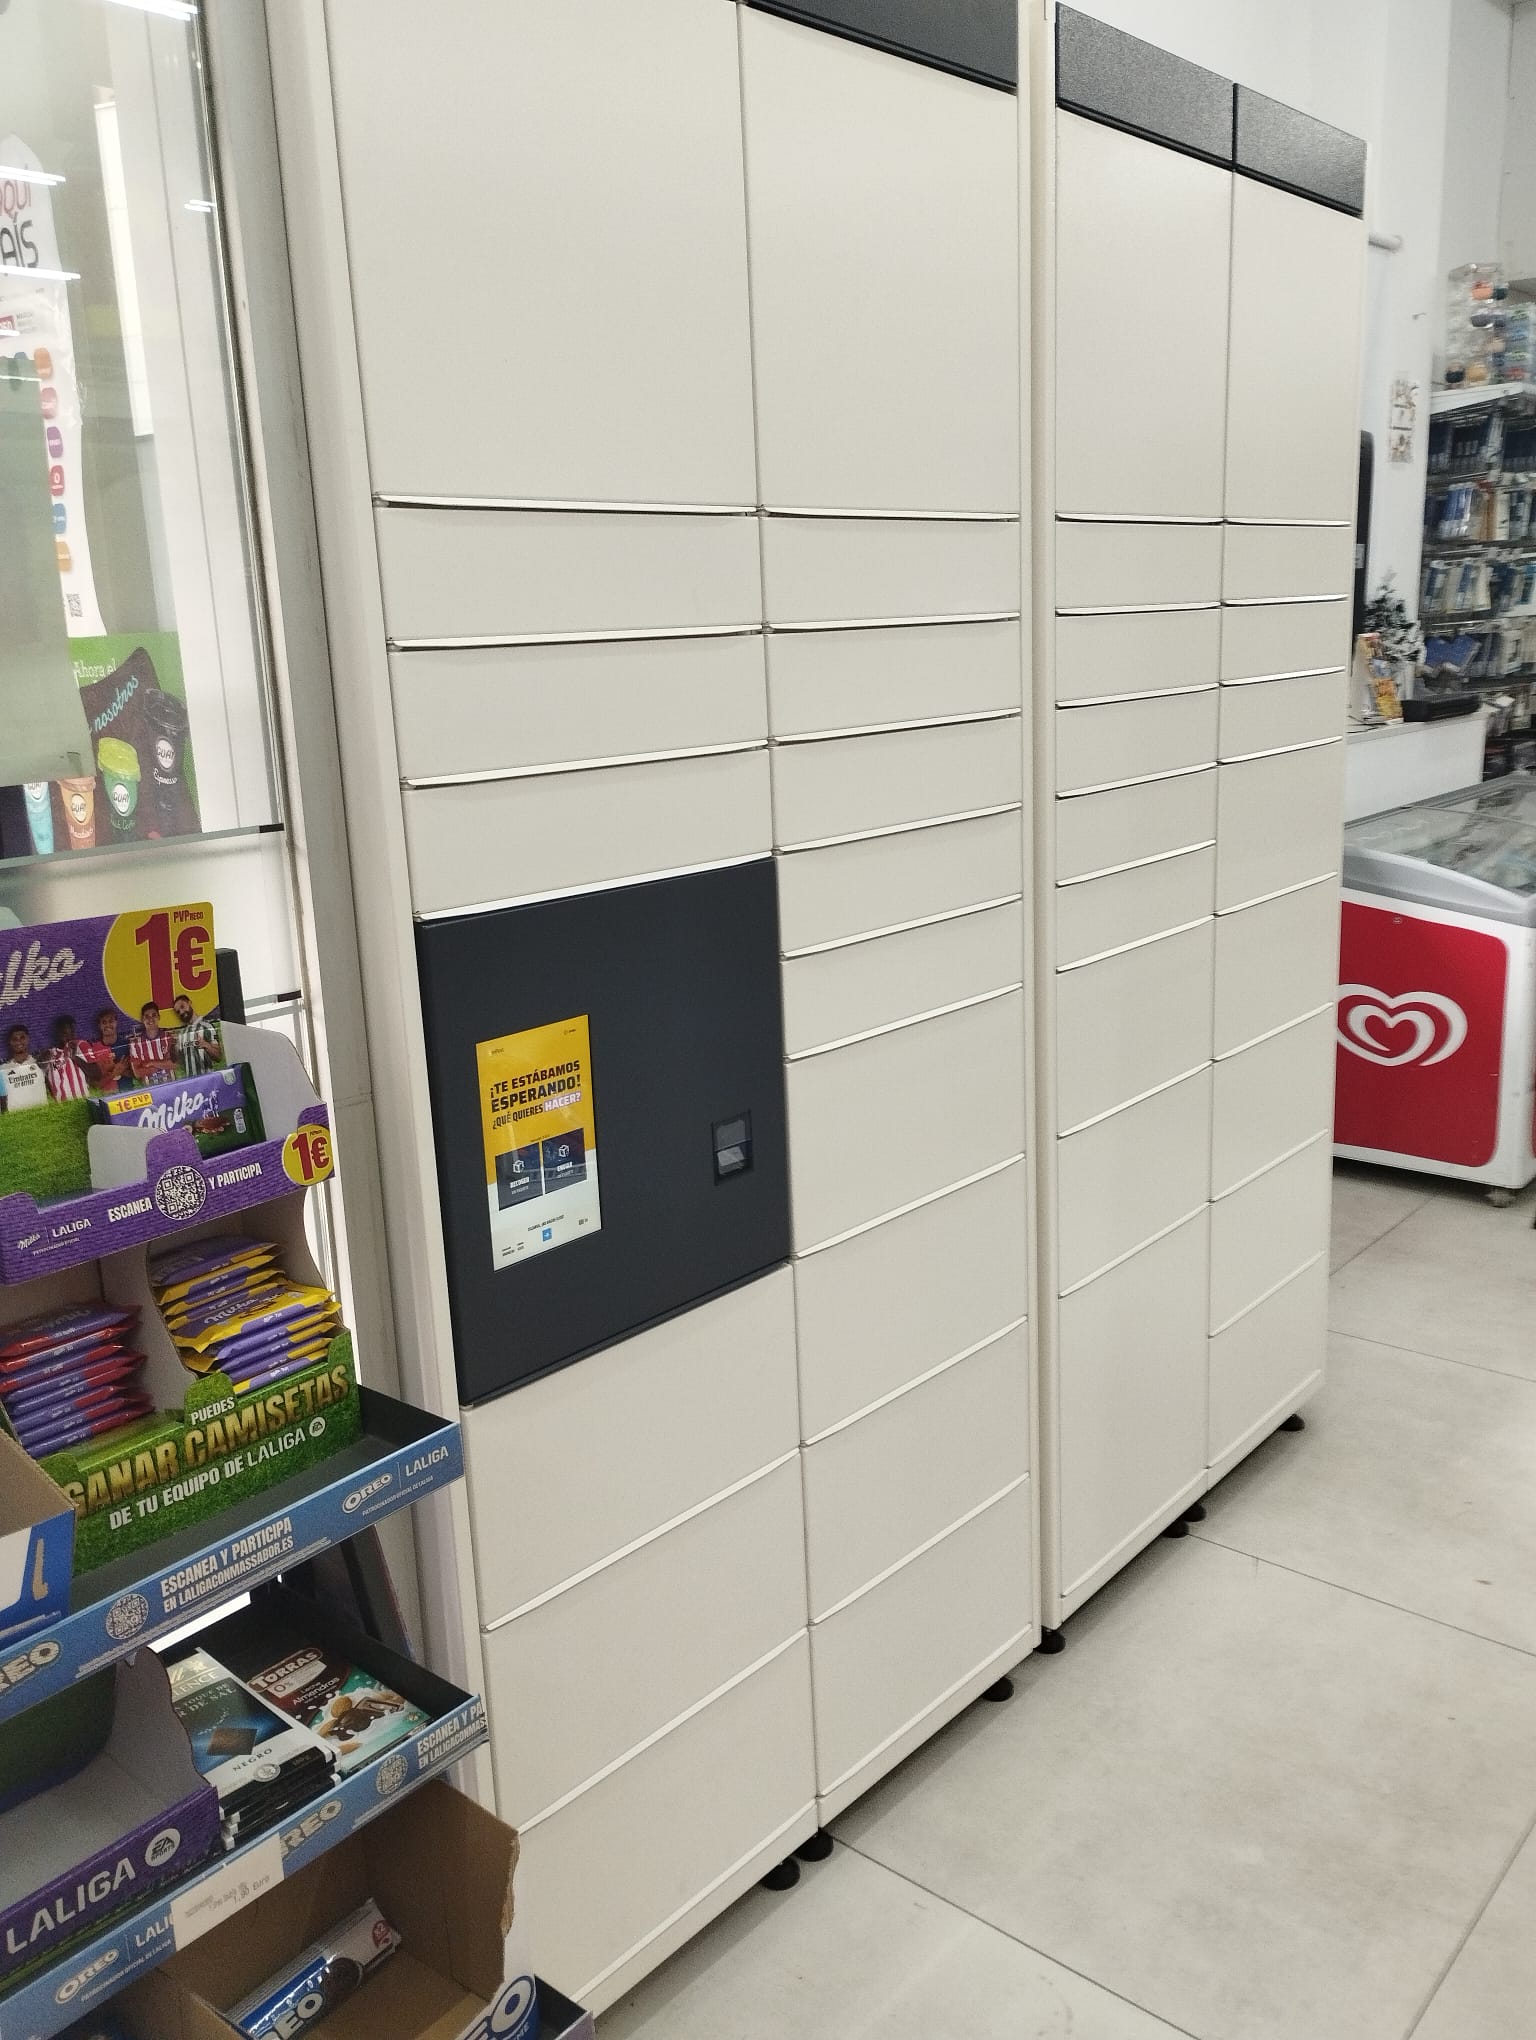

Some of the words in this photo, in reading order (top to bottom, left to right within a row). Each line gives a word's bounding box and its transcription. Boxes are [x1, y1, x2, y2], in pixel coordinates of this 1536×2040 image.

[135, 912, 212, 1010] 1€
[490, 1081, 508, 1098] ¡TE
[512, 1060, 580, 1089] ESTÁBAMOS
[491, 1074, 581, 1113] ESPERANDO!
[116, 1100, 132, 1113] 1€
[132, 1094, 150, 1105] PVP
[137, 1091, 204, 1132] Milka
[493, 1112, 511, 1130] ¿QUÉ
[512, 1104, 543, 1122] QUIERES
[544, 1092, 581, 1112] HACER?
[292, 1132, 330, 1181] 1€
[107, 1197, 153, 1223] ESCANEA
[208, 1177, 216, 1190] Y
[217, 1162, 262, 1188] PARTICIPA
[51, 1218, 92, 1238] LALIGA
[185, 1364, 350, 1468] CAMISETAS
[191, 1396, 236, 1426] PUEDES
[110, 1506, 132, 1530] DE
[139, 1495, 158, 1519] TU
[163, 1467, 220, 1506] EQUIPO
[224, 1455, 245, 1478] DE
[248, 1427, 306, 1467] LALIGA
[343, 1473, 392, 1513] OREO
[405, 1446, 449, 1477] LALIGA
[160, 1555, 218, 1597] ESCANEA
[219, 1548, 228, 1565] Y
[231, 1516, 293, 1560] PARTICIPA
[164, 1595, 177, 1613] EN
[179, 1535, 294, 1607] LALIGACONMASSABOR.ES
[250, 1652, 318, 1689] TORRAS
[293, 1676, 340, 1706] Almendras
[417, 1716, 461, 1756] ESCANEA
[461, 1709, 469, 1725] Y
[232, 1748, 273, 1772] NEGRO
[418, 1756, 429, 1769] EN
[6, 1857, 136, 1955] LALIGA
[55, 1949, 119, 2004] OREO
[259, 1992, 323, 2040] EO
